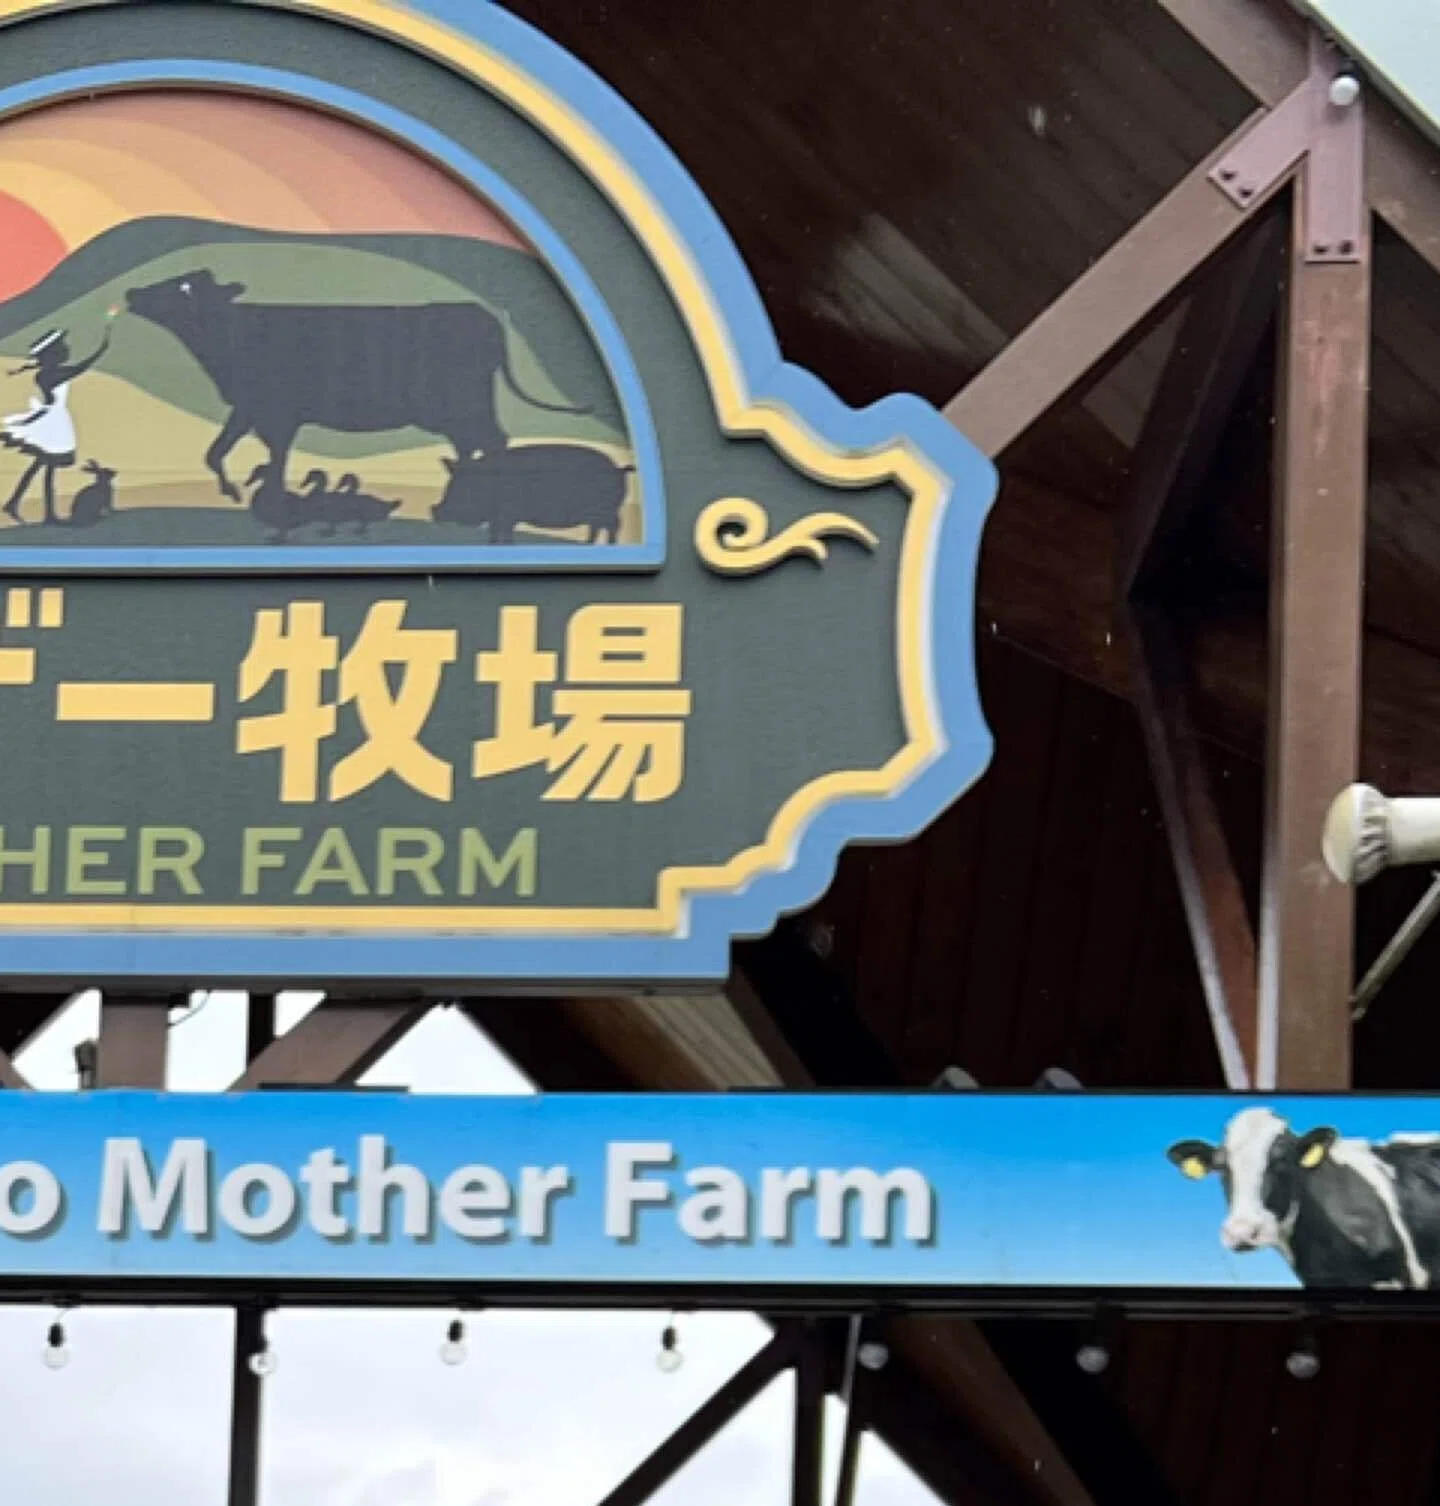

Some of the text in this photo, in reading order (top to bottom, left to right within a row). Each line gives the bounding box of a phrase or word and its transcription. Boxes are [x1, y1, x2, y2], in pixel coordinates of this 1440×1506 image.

[241, 827, 537, 897] FARM
[97, 1137, 567, 1240] Mother
[605, 1142, 932, 1242] Farm
